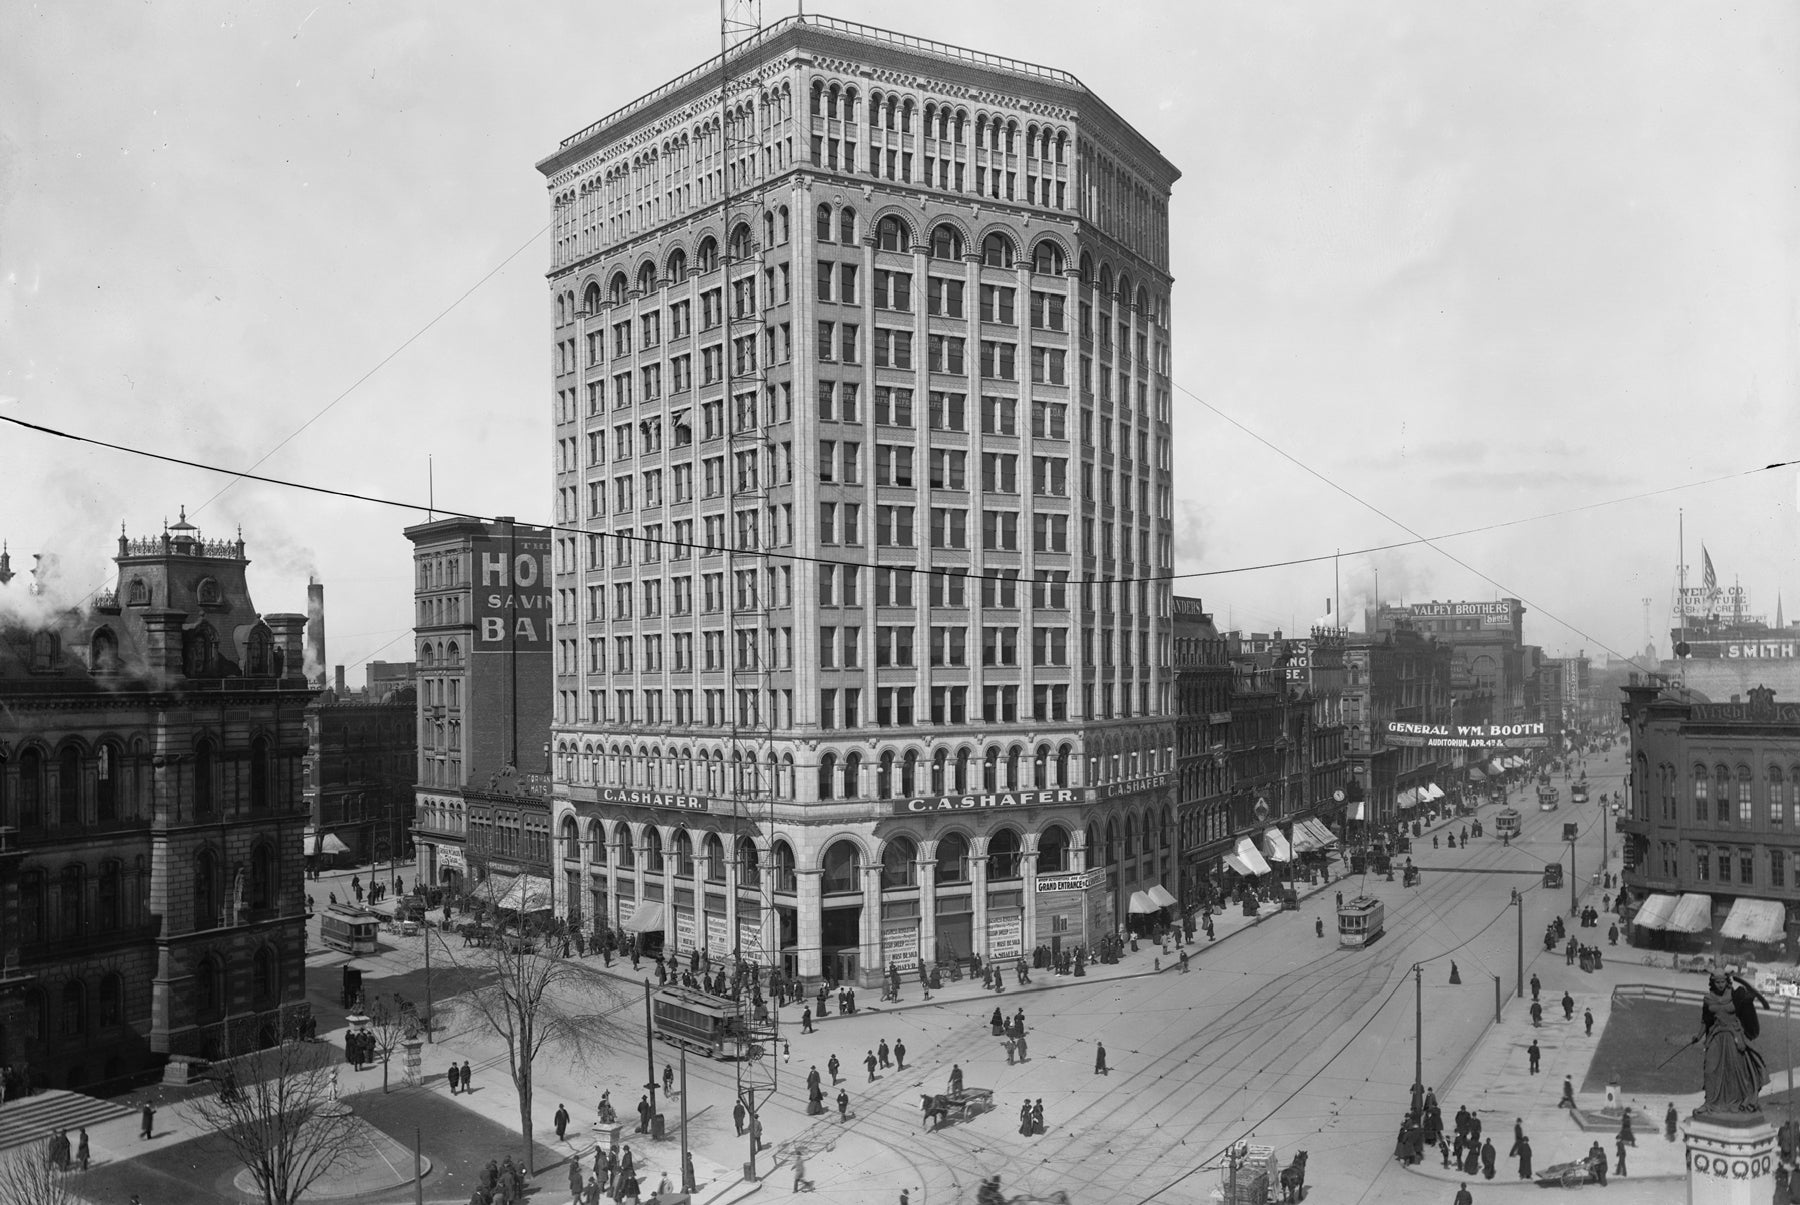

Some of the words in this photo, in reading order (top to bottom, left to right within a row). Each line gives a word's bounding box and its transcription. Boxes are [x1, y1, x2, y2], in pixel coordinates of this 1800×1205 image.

[1414, 604, 1452, 616] VALPEY
[1455, 603, 1509, 615] BROTHERS
[1728, 643, 1794, 658] SMITH
[1388, 721, 1449, 735] GENERAL
[1457, 724, 1484, 736] WM.
[1490, 722, 1545, 736] BOOTH
[1038, 882, 1057, 892] GRAND
[1058, 880, 1083, 890] ENTRANCE
